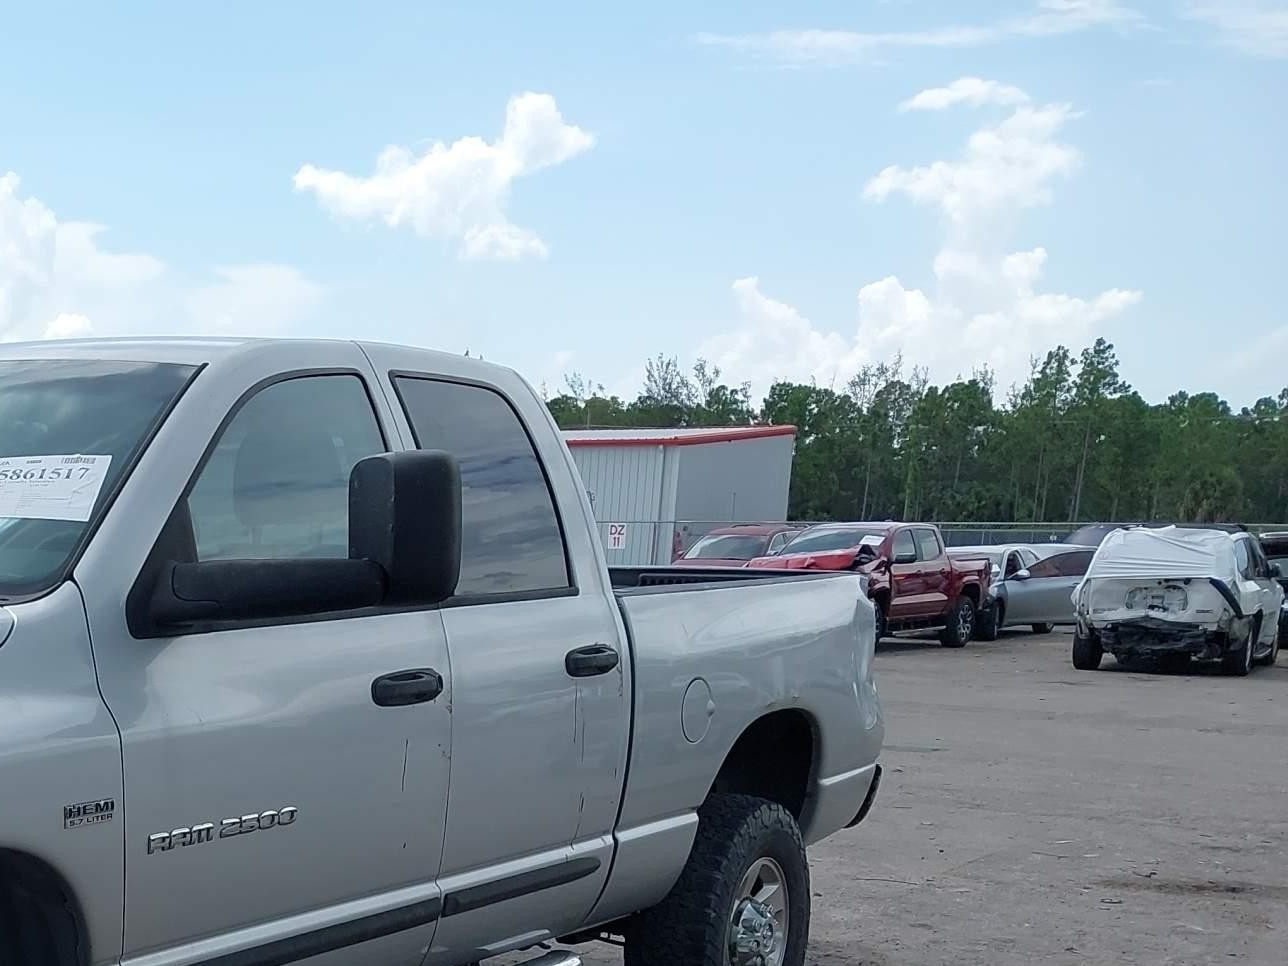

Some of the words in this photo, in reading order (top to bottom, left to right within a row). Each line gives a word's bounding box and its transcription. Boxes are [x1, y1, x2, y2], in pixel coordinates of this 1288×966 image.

[609, 525, 625, 536] DZ
[68, 799, 114, 819] HEMI
[69, 818, 83, 827] 5.7
[86, 812, 113, 823] LITER
[147, 822, 214, 855] RAM
[219, 806, 298, 838] 2500
